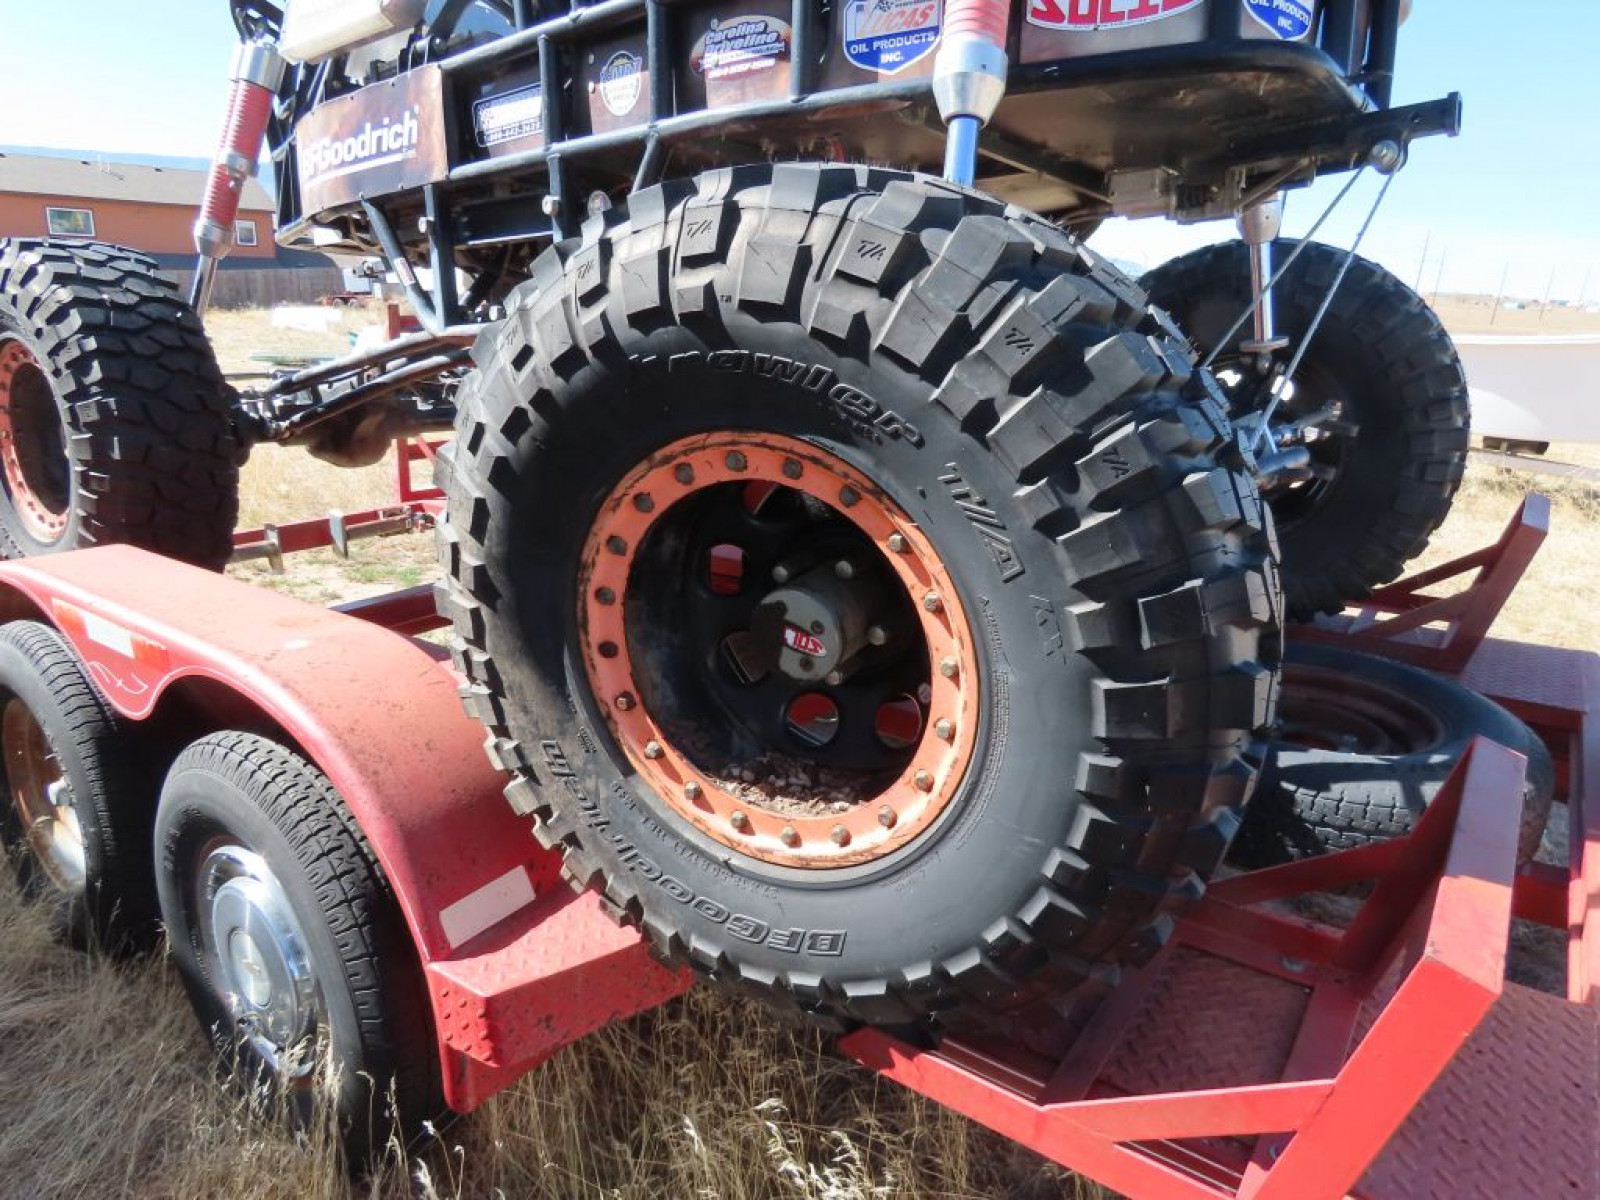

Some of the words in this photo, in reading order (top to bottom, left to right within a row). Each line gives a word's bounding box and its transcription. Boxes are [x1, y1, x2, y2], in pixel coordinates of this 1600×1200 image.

[850, 44, 869, 54] OIL
[873, 31, 935, 50] PRODUCTS
[881, 52, 904, 64] INC.
[302, 108, 419, 178] BFGoodrich
[628, 349, 925, 451] rawler
[541, 740, 848, 957] BFGoodrich
